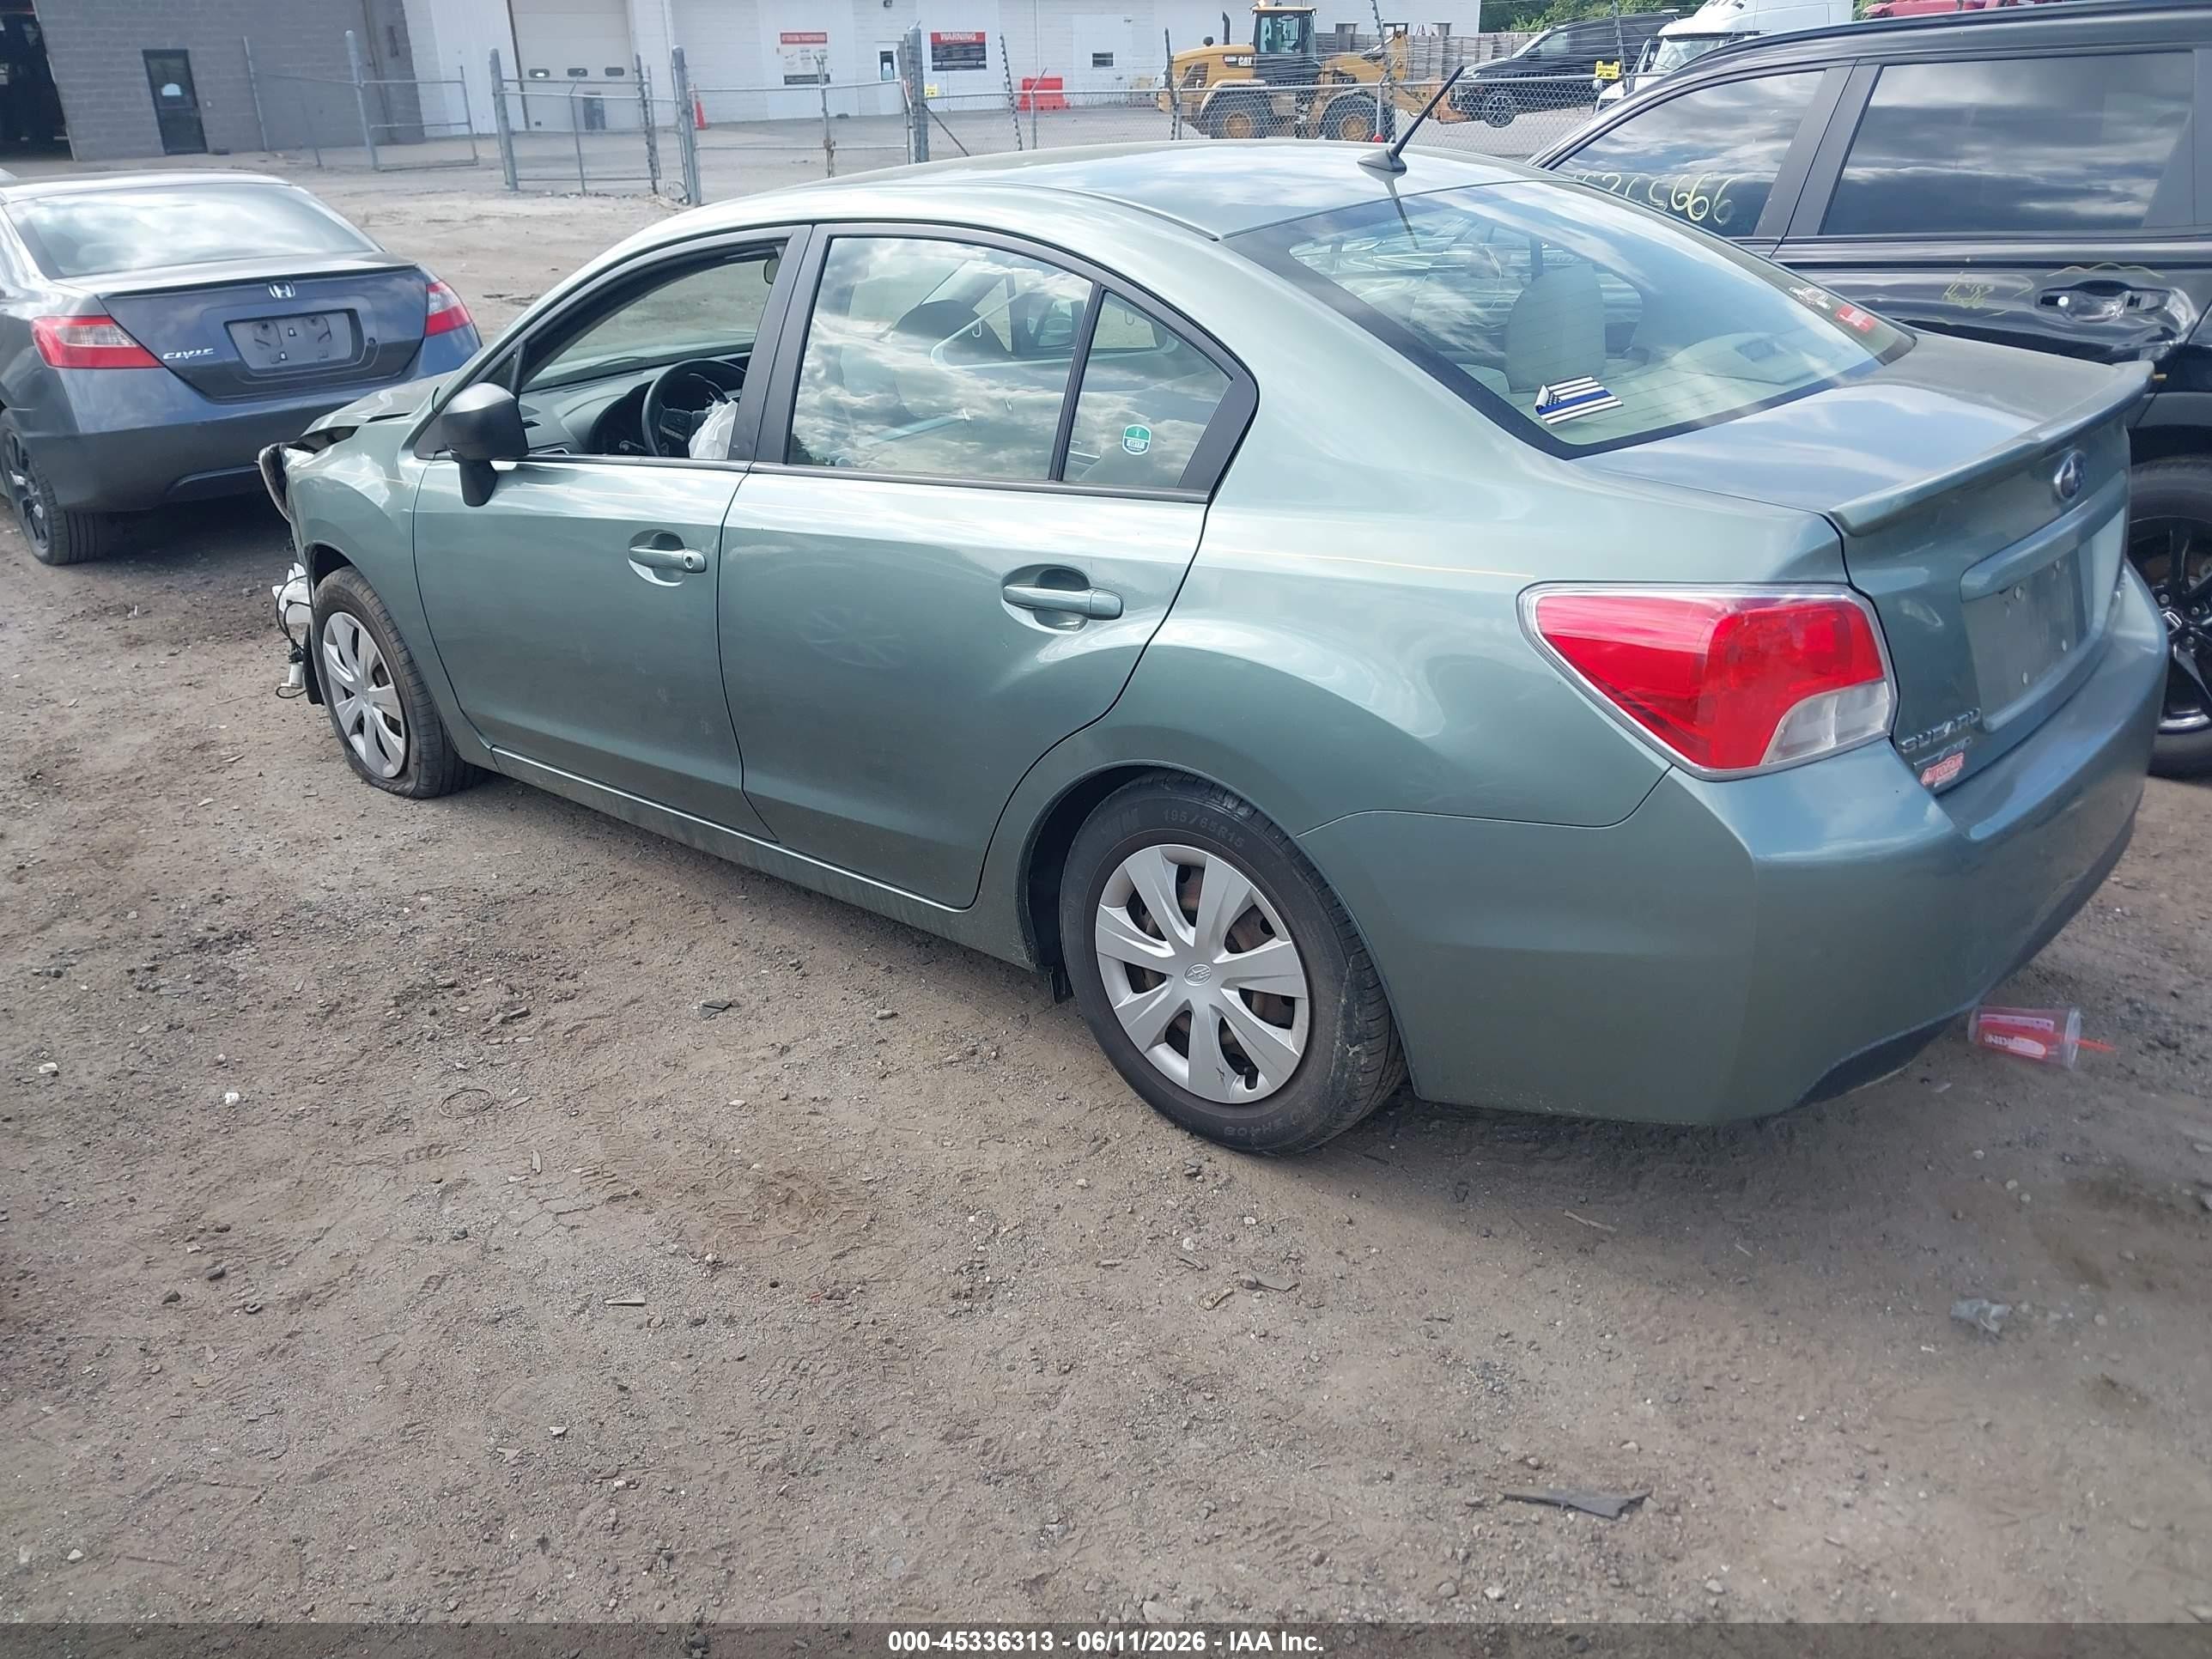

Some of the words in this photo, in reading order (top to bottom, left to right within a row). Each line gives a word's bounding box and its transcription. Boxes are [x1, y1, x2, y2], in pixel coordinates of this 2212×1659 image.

[939, 32, 976, 41] WARNING
[1238, 56, 1252, 66] CAT
[162, 348, 214, 359] CIVIC
